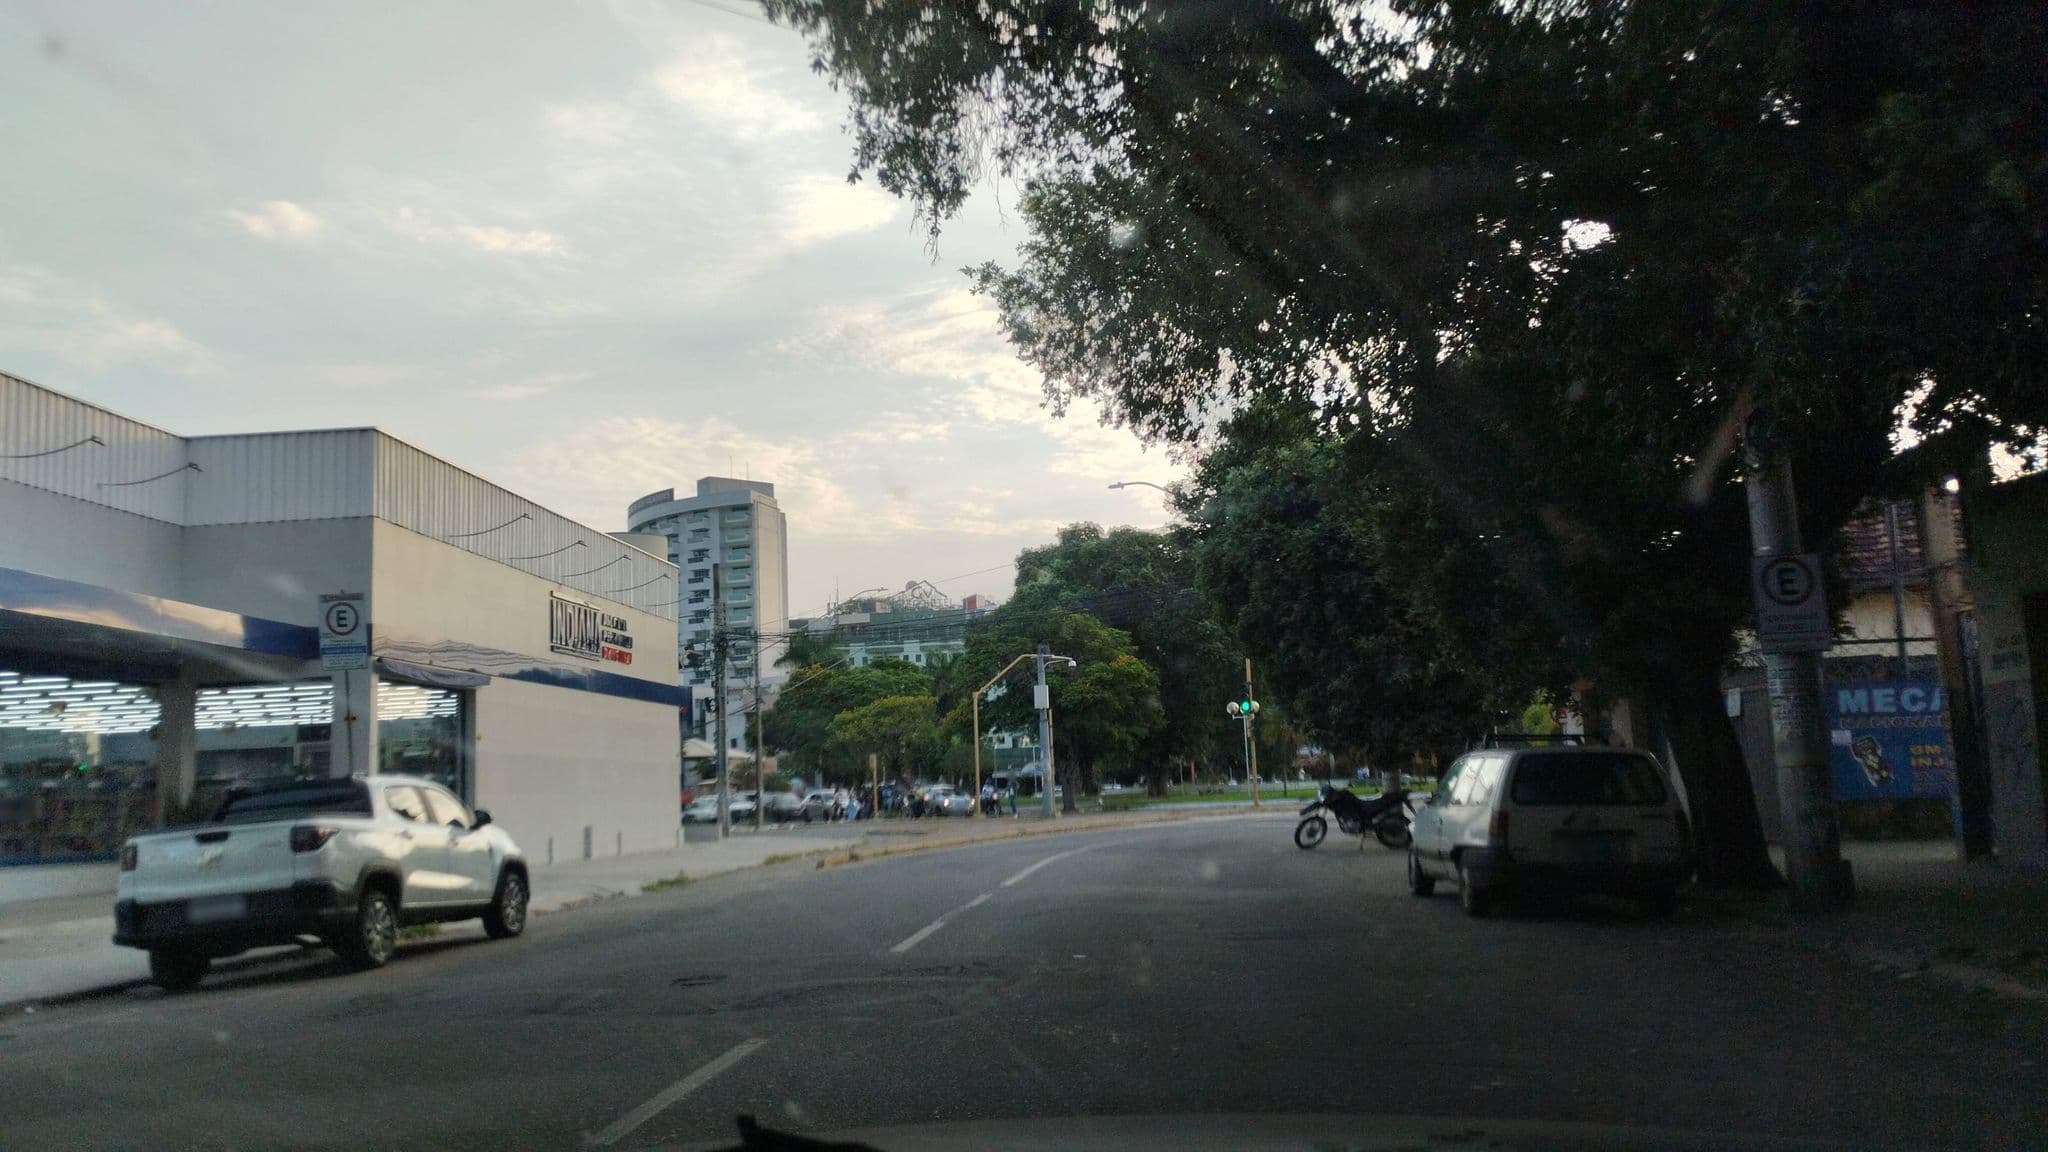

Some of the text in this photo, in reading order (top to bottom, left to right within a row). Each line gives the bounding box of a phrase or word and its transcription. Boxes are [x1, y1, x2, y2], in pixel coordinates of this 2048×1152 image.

[1777, 567, 1798, 595] E
[335, 609, 348, 628] E
[550, 598, 601, 654] INDIANA
